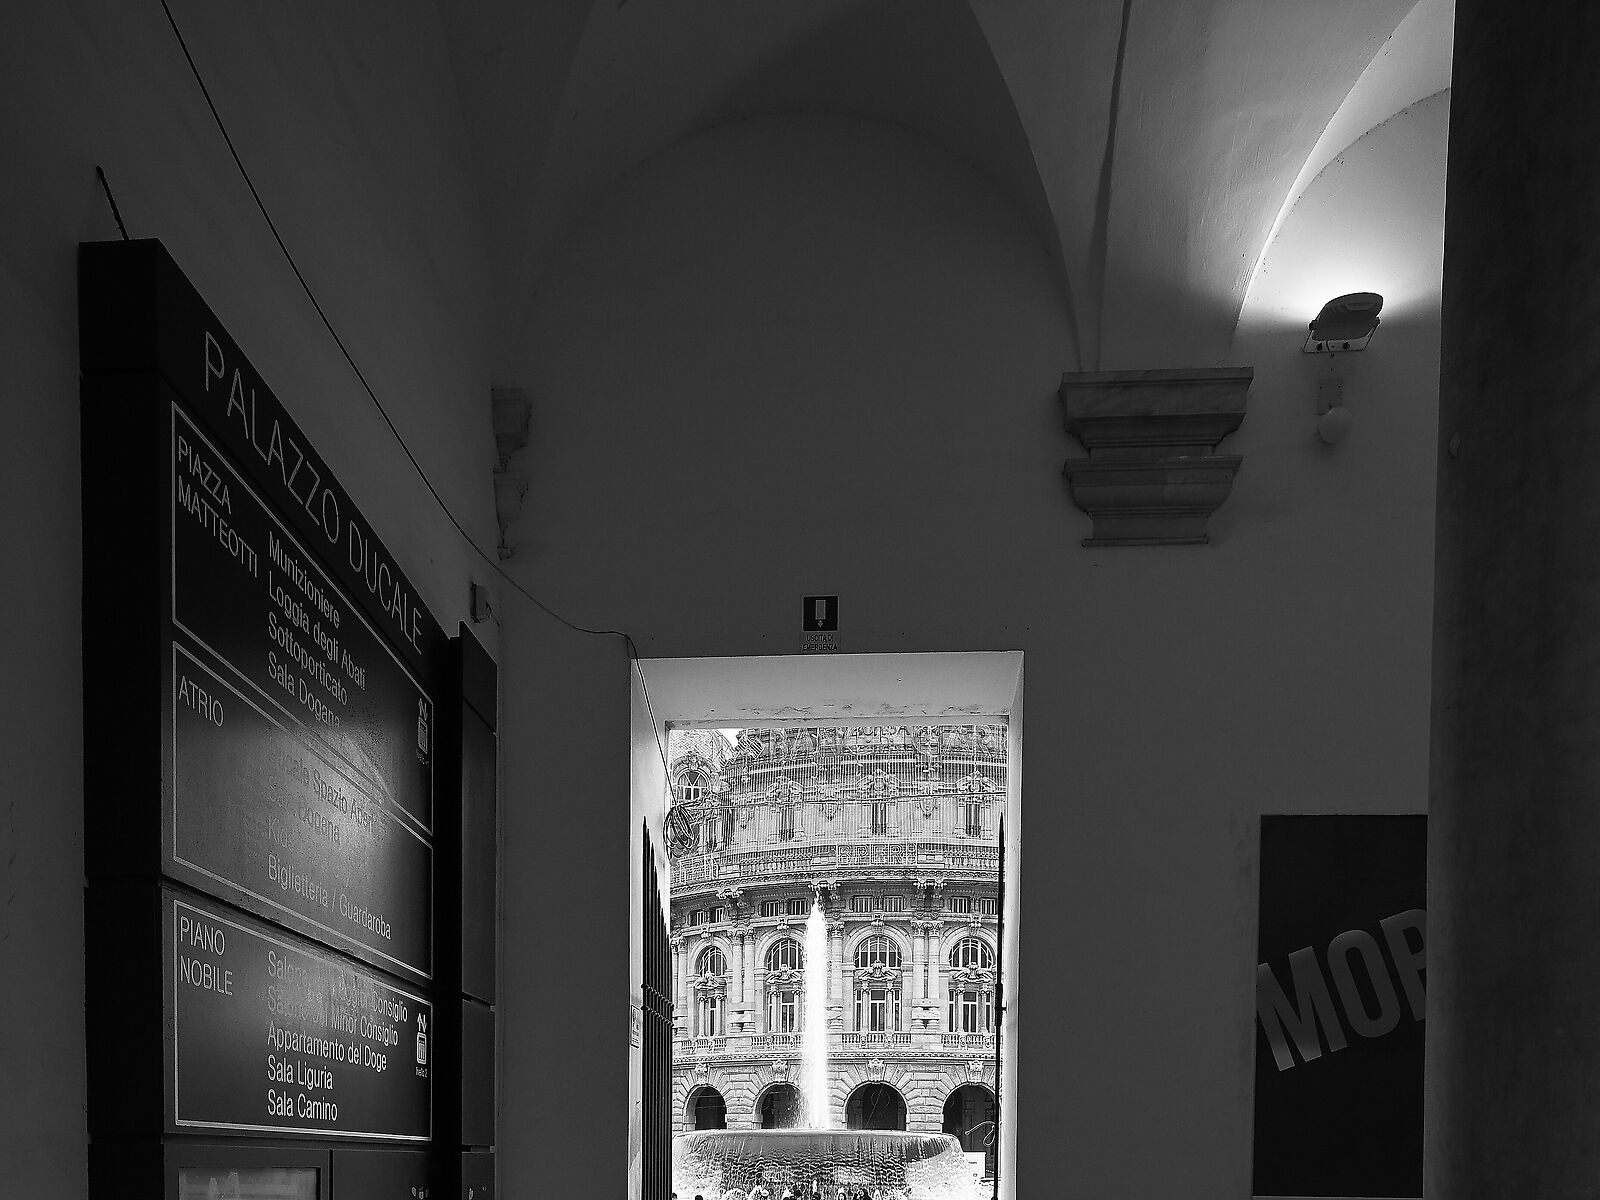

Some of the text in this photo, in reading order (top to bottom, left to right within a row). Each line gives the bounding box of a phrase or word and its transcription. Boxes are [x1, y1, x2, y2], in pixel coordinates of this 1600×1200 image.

[178, 435, 232, 515] PIAZZA
[205, 332, 423, 656] PALAZZO DUCALE
[178, 475, 258, 579] MATTEOTTI
[269, 530, 341, 629] Munizioniere
[268, 611, 348, 706] Sottoporticato
[269, 570, 366, 691] Loggia degli Abati
[178, 675, 224, 727] ATRIO
[268, 650, 340, 728] Sala Dogana
[268, 852, 329, 908] Biglietteria
[339, 892, 392, 940] Guardaroba
[180, 915, 226, 957] PIANO
[180, 955, 233, 997] NOBILE
[372, 989, 409, 1024] Consiglio
[267, 1020, 345, 1062] Appartamento
[348, 1042, 362, 1066] del
[364, 1044, 387, 1073] Doge
[359, 1014, 400, 1048] Consiglio
[267, 1054, 334, 1091] Sala Liguria
[267, 1088, 338, 1122] Sala Camino
